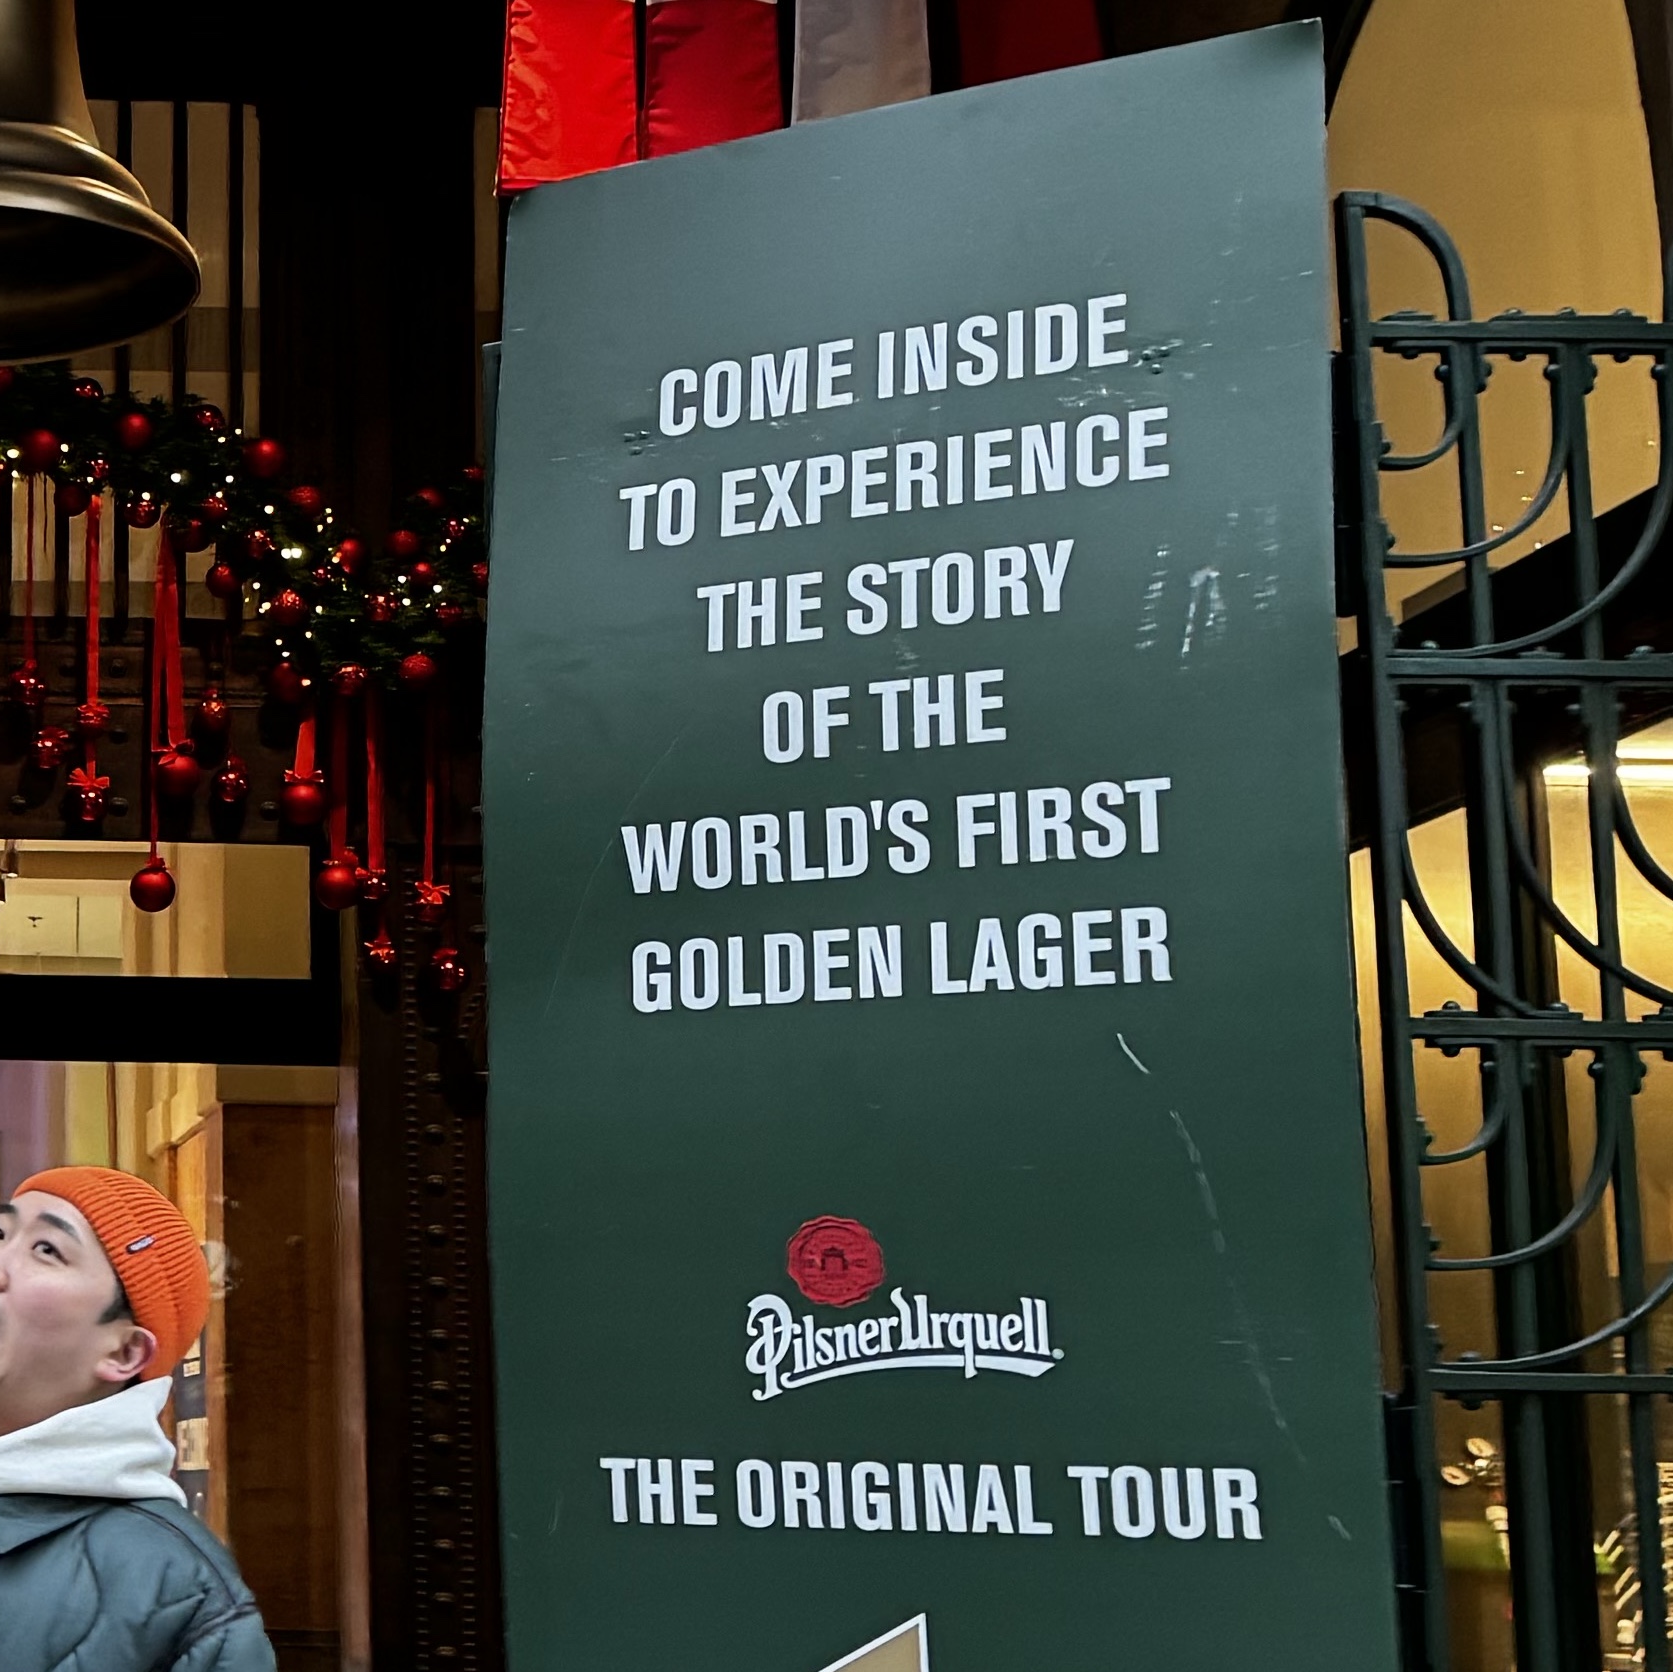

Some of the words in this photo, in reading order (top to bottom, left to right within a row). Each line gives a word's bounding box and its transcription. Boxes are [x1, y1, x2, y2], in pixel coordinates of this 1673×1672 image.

[659, 339, 854, 437] COME
[878, 294, 1130, 399] INSIDE
[620, 478, 697, 551] TO
[720, 407, 1170, 538] EXPERIENCE
[697, 571, 824, 653] THE
[847, 539, 1075, 635] STORY
[763, 686, 850, 764] OF
[869, 669, 1007, 752] THE
[621, 800, 931, 894] WORLD'S
[957, 778, 1171, 868] FIRST
[632, 925, 903, 1013] GOLDEN
[931, 907, 1173, 995] LAGER
[746, 1293, 899, 1400] Pilsner
[891, 1287, 1051, 1378] Urquell
[599, 1458, 718, 1526] THE
[736, 1459, 1053, 1535] ORIGINAL
[1067, 1466, 1263, 1540] TOUR
